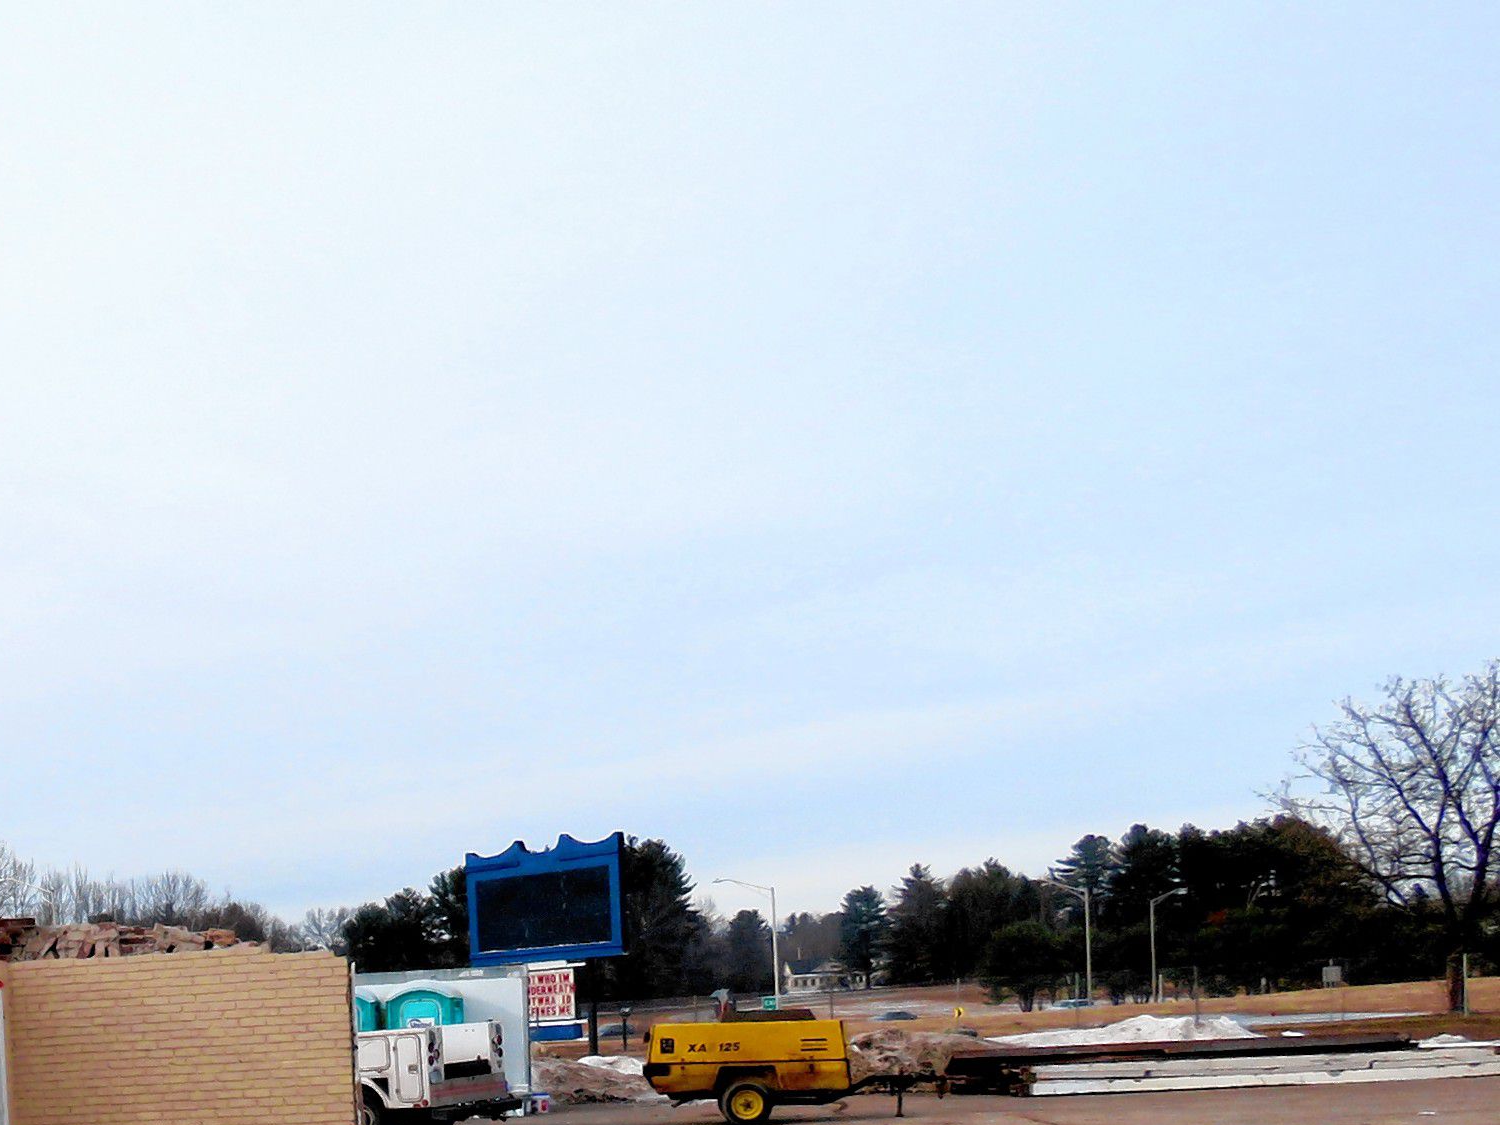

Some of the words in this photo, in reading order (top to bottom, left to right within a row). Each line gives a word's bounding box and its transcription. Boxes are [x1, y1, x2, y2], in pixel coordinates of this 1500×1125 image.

[537, 974, 557, 984] WHO
[687, 1043, 707, 1052] XA
[718, 1041, 741, 1052] 125
